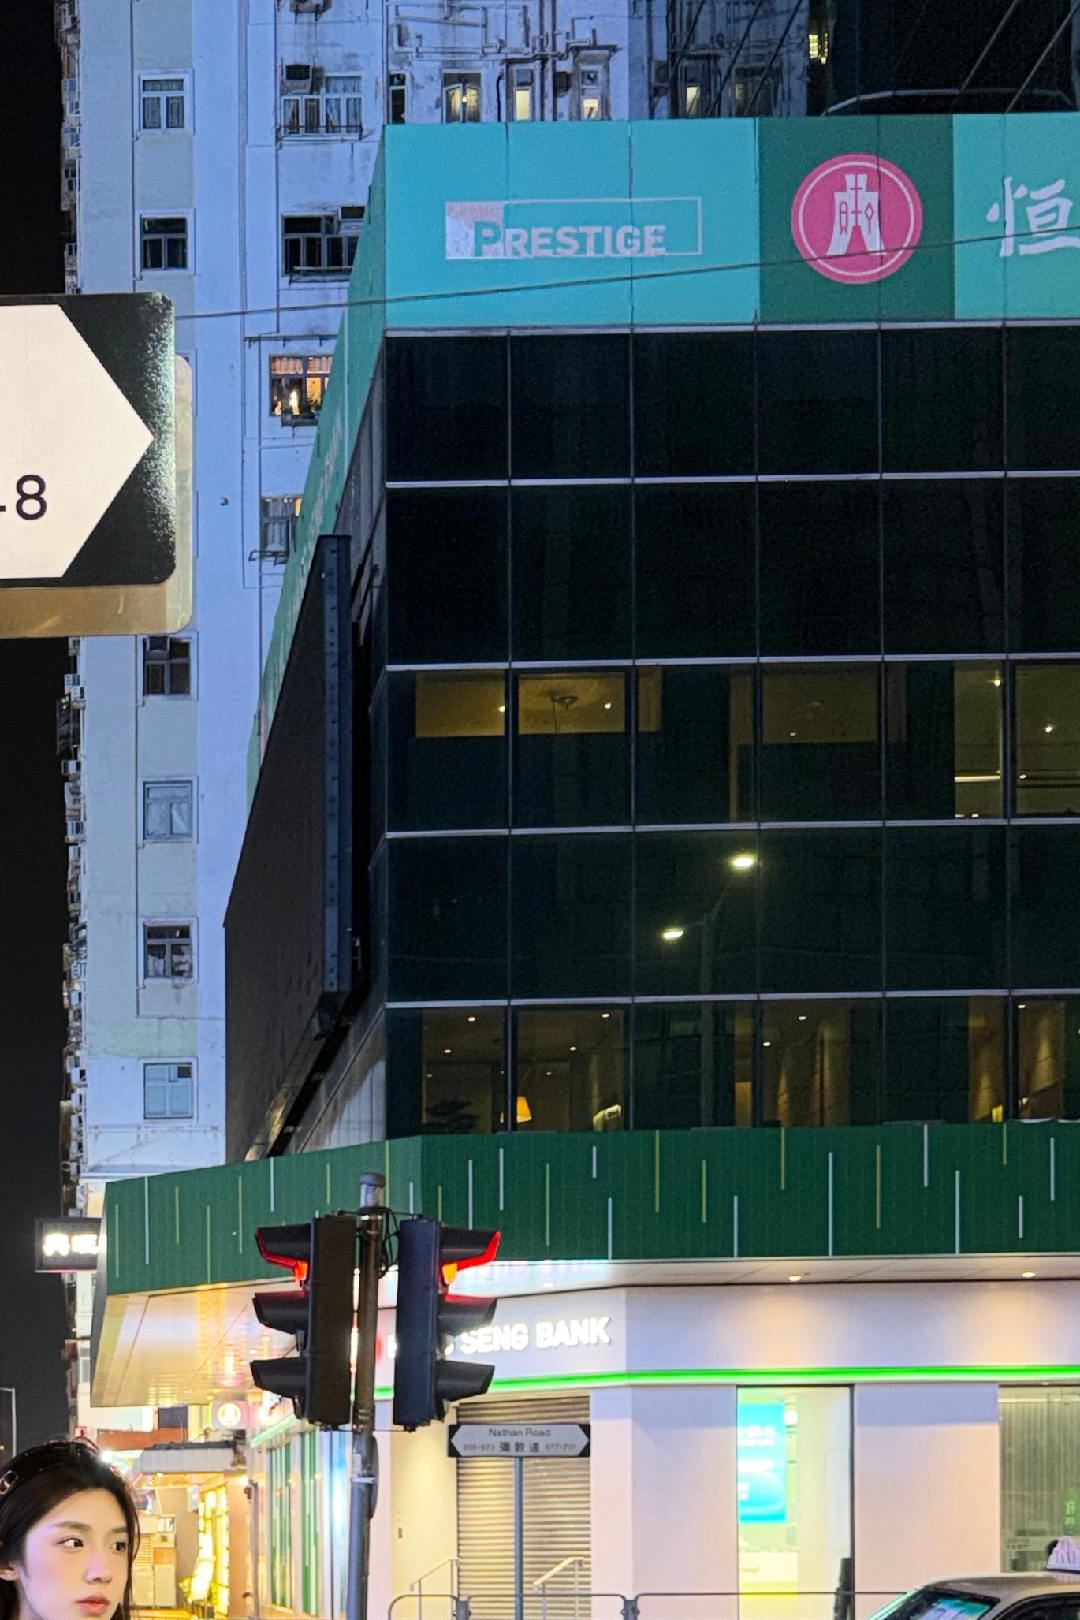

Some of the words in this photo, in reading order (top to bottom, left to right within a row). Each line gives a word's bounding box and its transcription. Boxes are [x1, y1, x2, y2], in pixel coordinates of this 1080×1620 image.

[985, 176, 1080, 256] 恒
[474, 221, 666, 258] PRESTIGE
[460, 1323, 529, 1355] SENG
[536, 1317, 610, 1349] BANK
[488, 1428, 523, 1437] Nathan
[525, 1428, 552, 1437] Road
